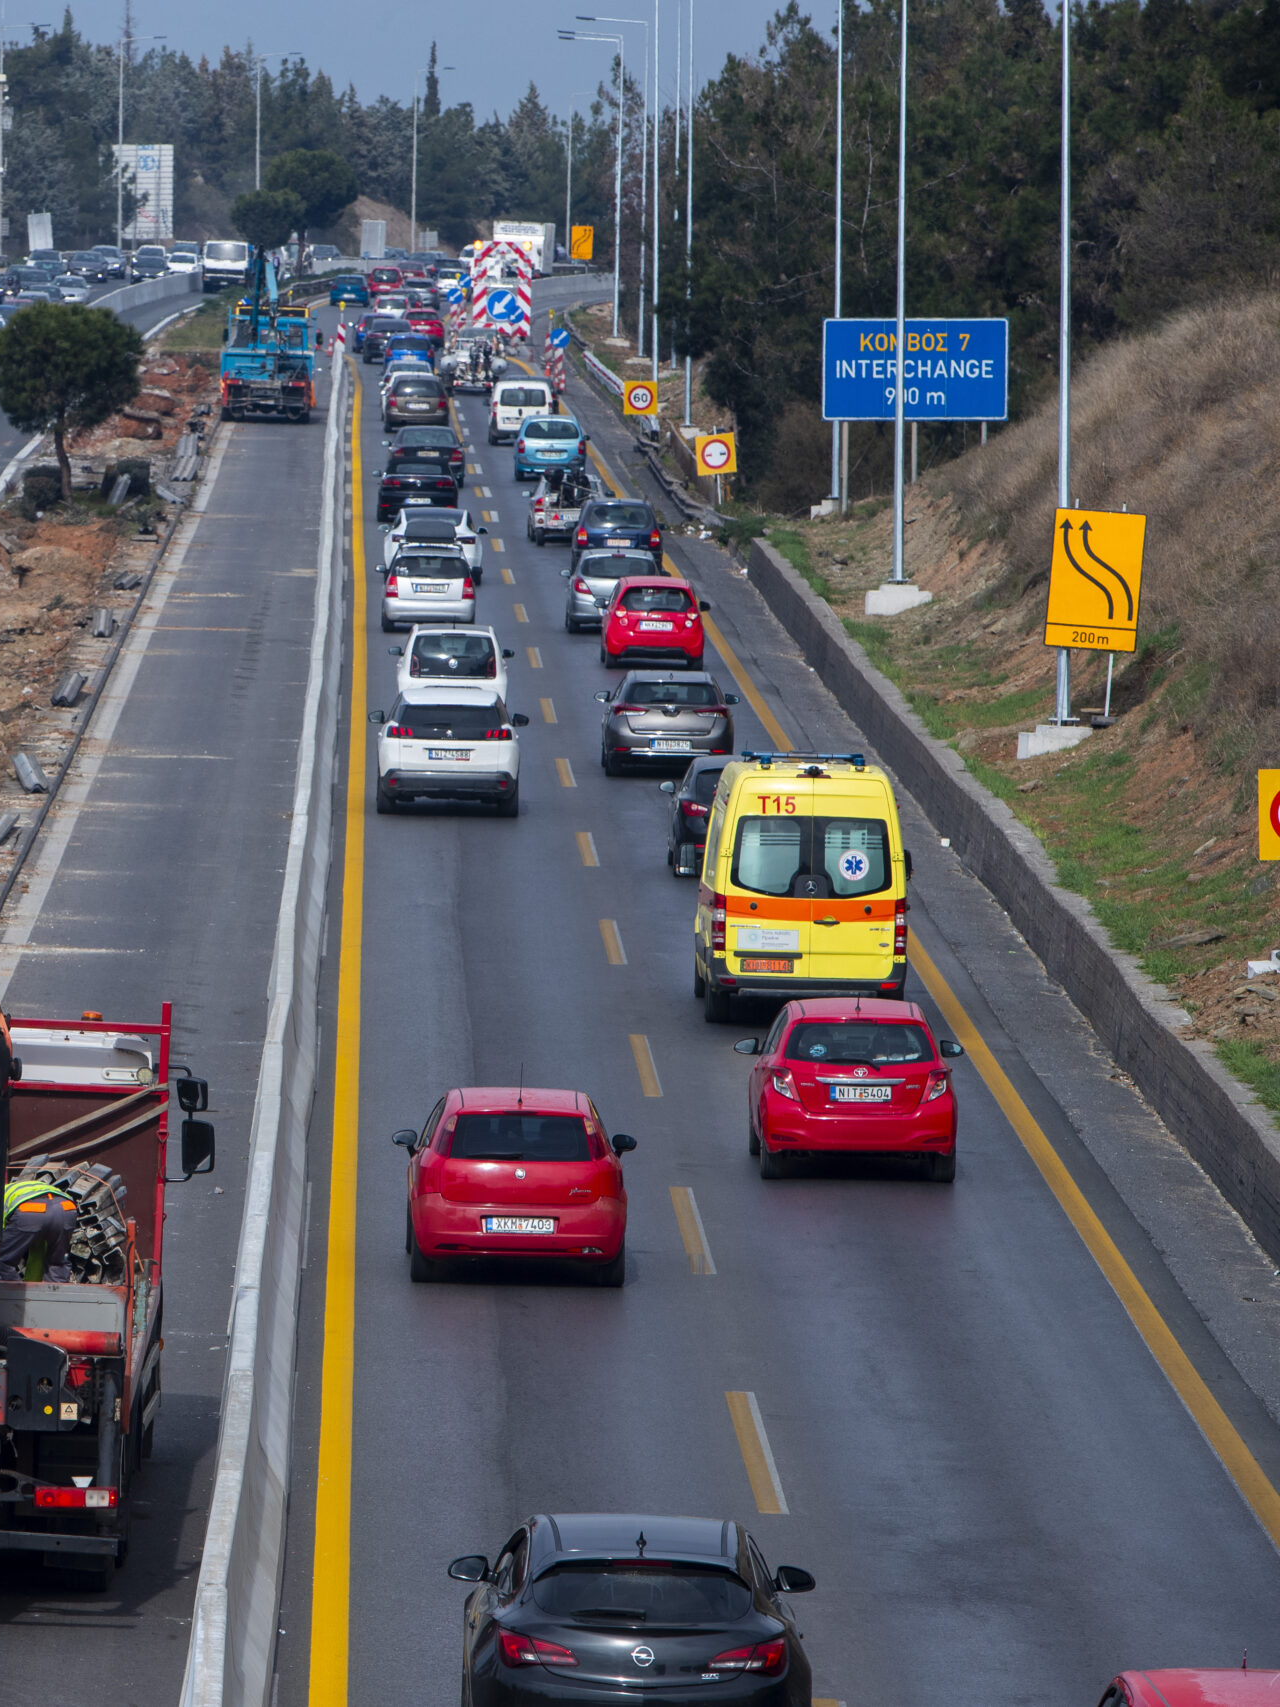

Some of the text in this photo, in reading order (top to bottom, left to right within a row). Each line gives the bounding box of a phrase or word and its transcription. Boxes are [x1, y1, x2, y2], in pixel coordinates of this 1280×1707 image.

[959, 333, 970, 352] 7
[836, 360, 994, 379] INTERCHANGE
[633, 393, 648, 403] 60
[926, 391, 945, 405] m
[757, 795, 796, 815] T15
